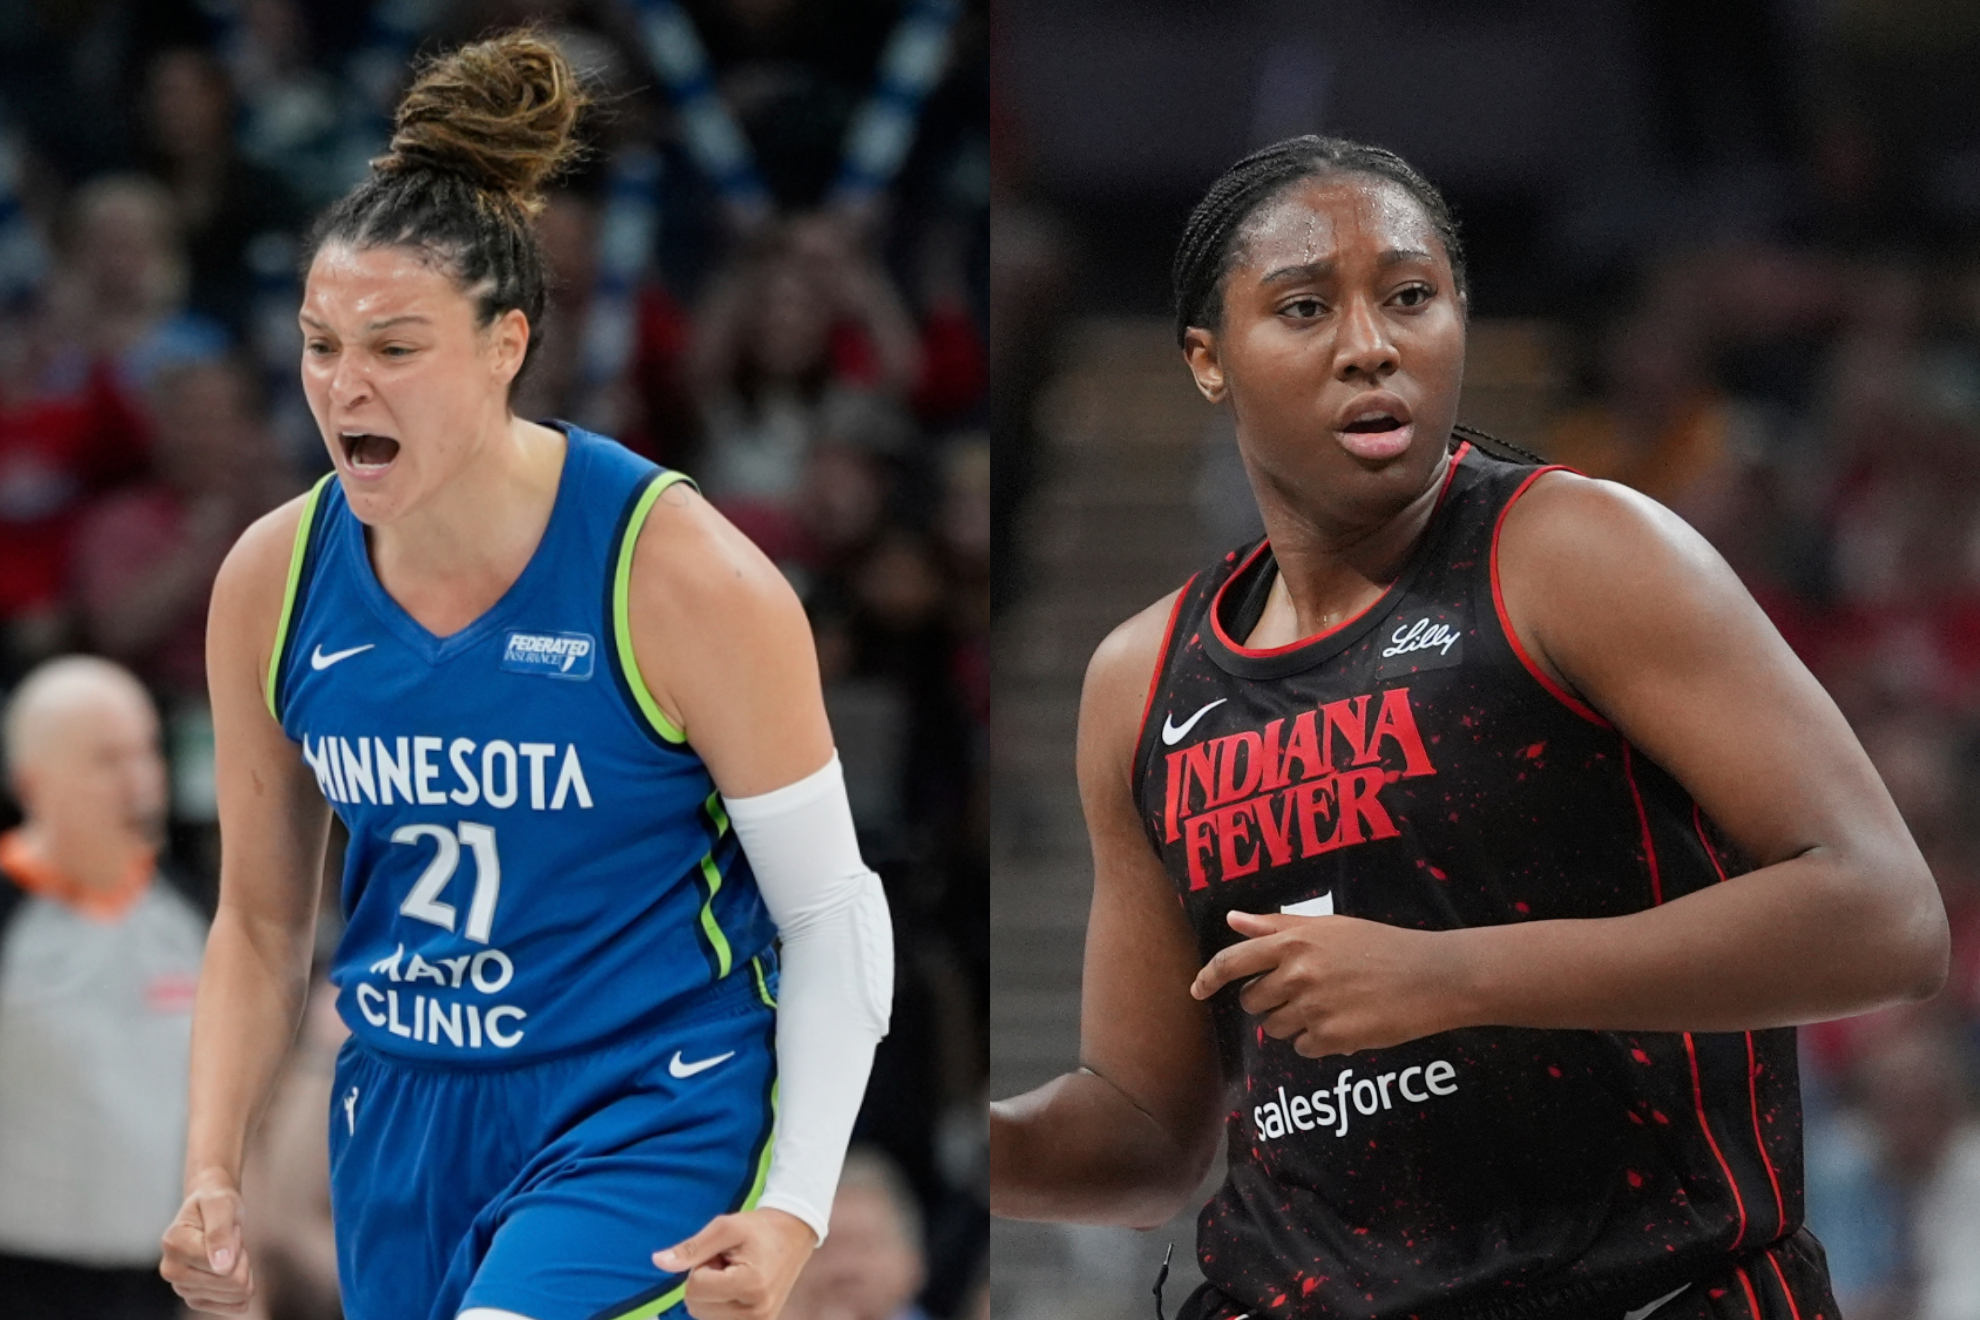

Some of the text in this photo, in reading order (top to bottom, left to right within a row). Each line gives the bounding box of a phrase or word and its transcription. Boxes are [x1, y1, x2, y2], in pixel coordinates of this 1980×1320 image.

[508, 634, 590, 657] FEDERATED
[1382, 617, 1460, 656] Lilly
[303, 733, 593, 810] MINNESOTA
[1164, 687, 1436, 844] INDIANA
[1185, 766, 1400, 891] FEVER
[391, 820, 500, 944] 21
[356, 982, 527, 1048] CLINIC
[1253, 1059, 1459, 1142] salesforce
